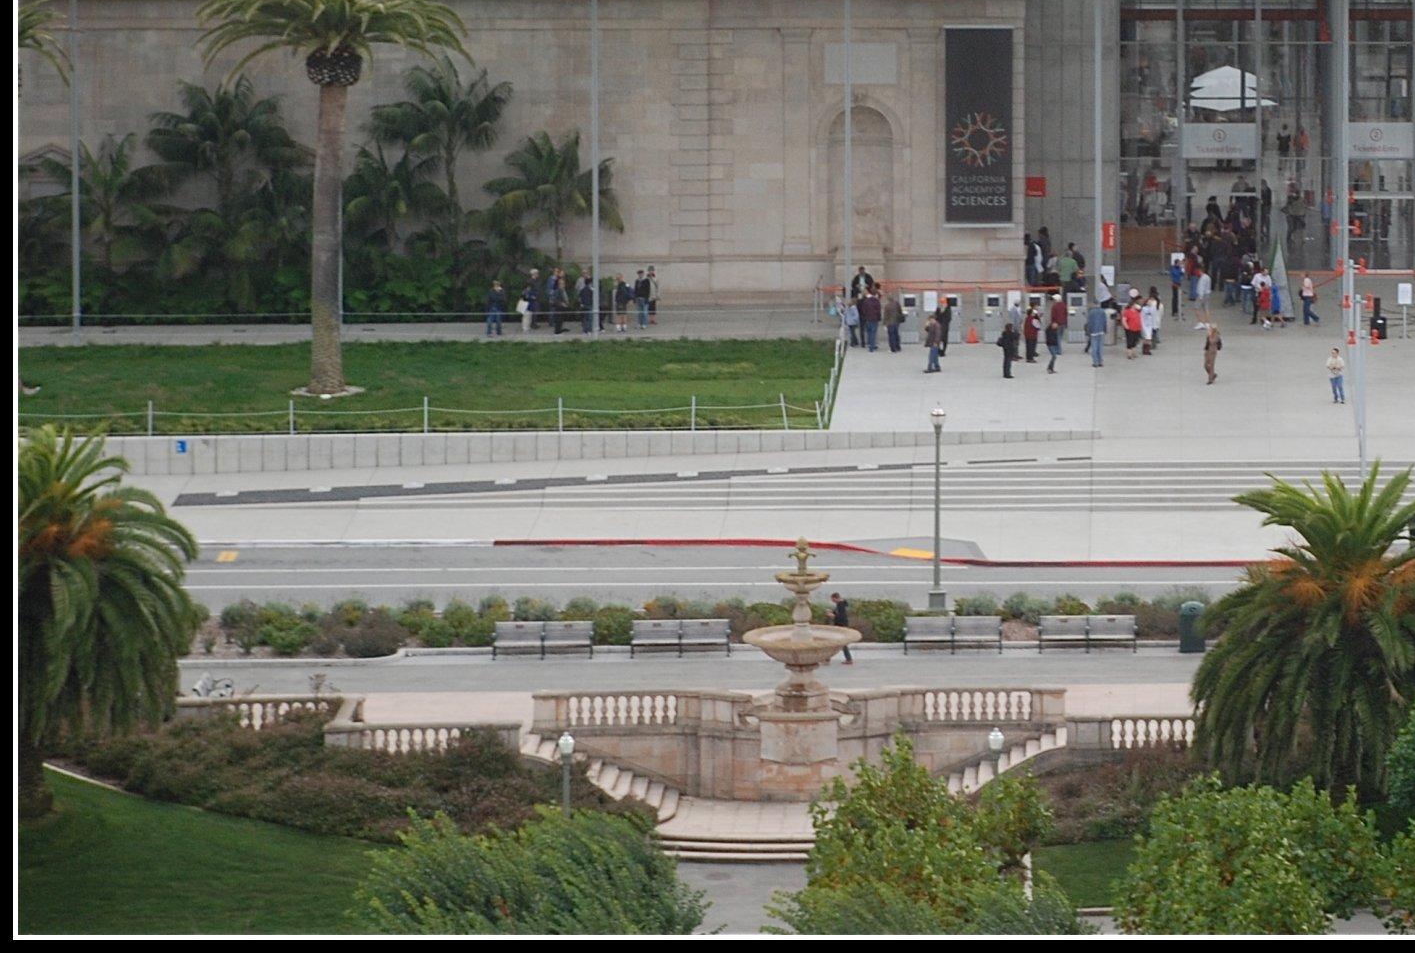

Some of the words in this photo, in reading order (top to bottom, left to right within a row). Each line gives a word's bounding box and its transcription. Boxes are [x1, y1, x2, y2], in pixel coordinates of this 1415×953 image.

[951, 175, 1007, 184] CALIFORNIA
[951, 185, 993, 194] ACADEMY
[993, 185, 1006, 194] OF
[951, 196, 1007, 206] SCIENCES
